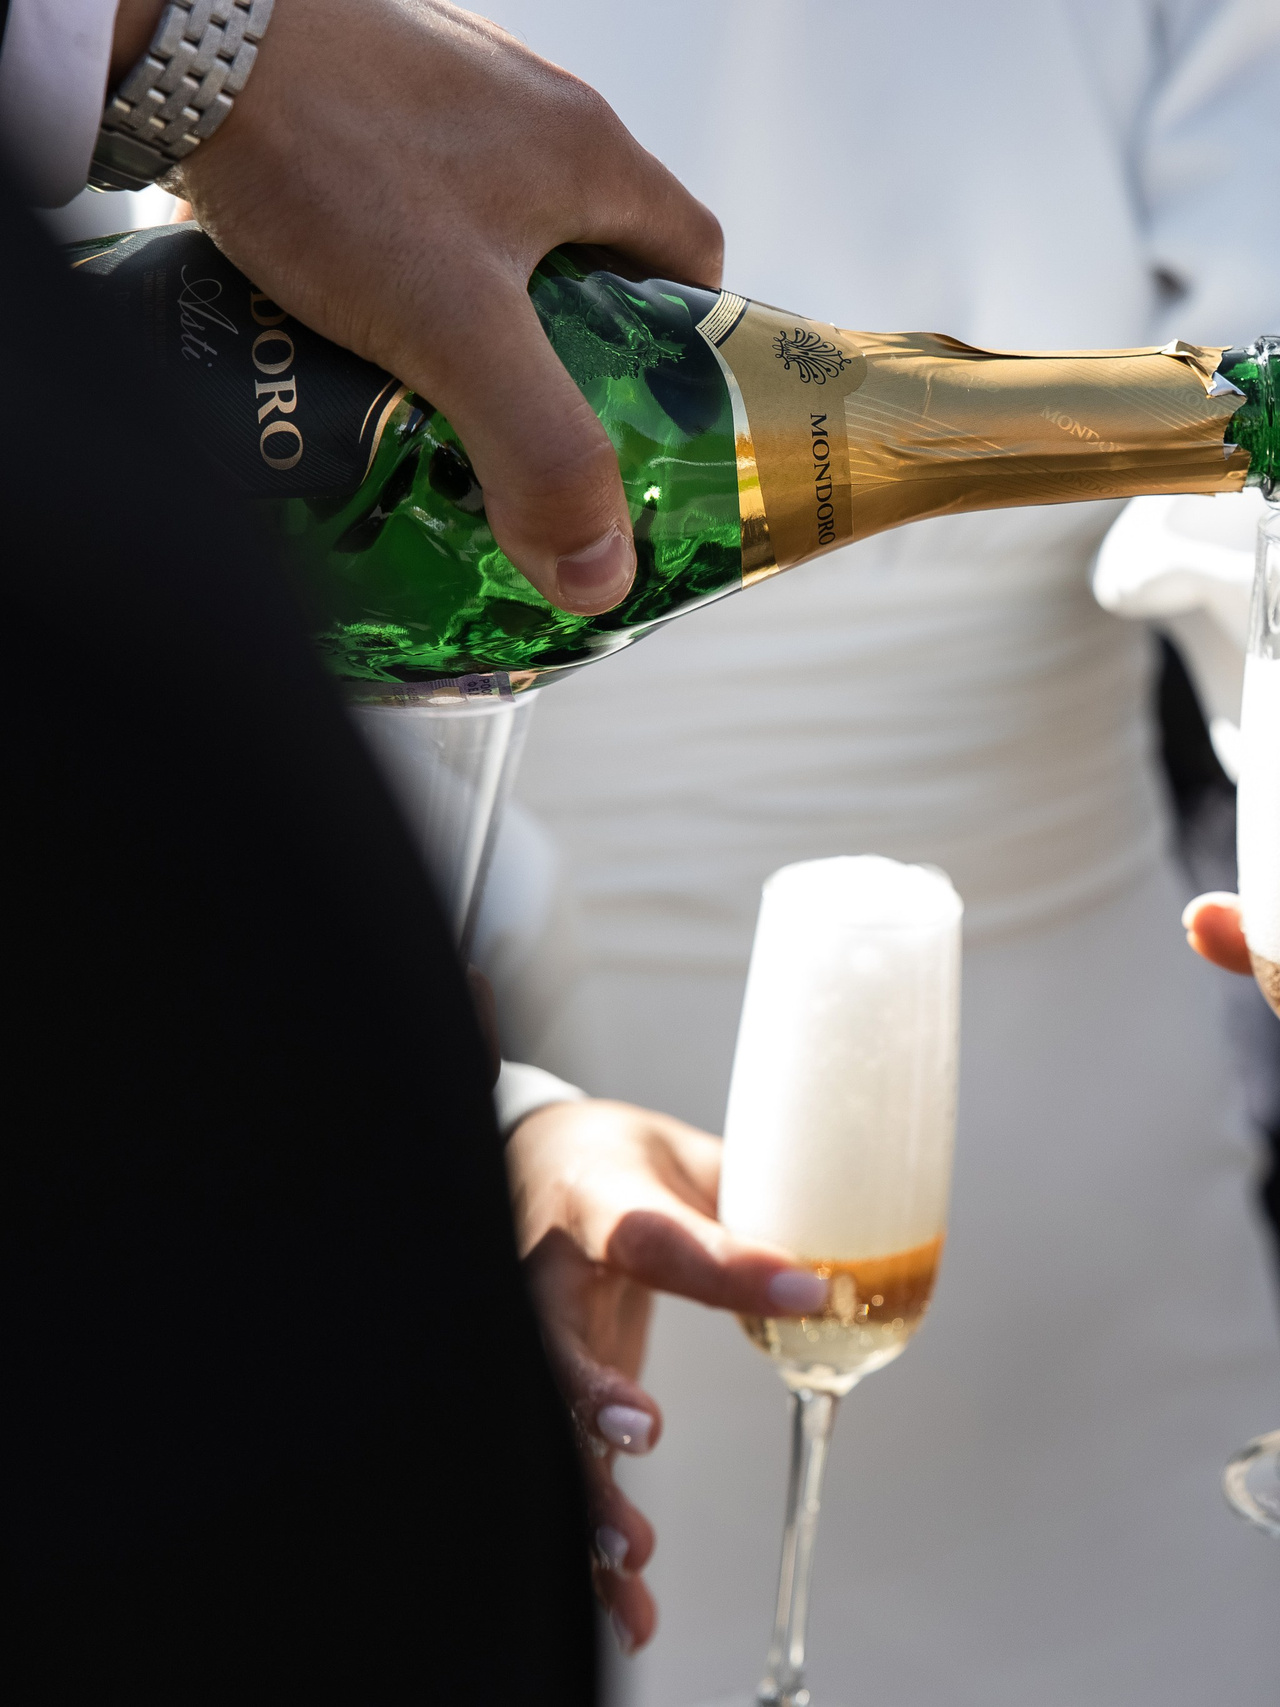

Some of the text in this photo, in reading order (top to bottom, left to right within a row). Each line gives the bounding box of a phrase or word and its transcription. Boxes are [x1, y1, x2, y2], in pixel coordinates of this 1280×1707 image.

[178, 265, 239, 367] Asti
[250, 289, 303, 470] DORO
[810, 412, 836, 546] MONDORO
